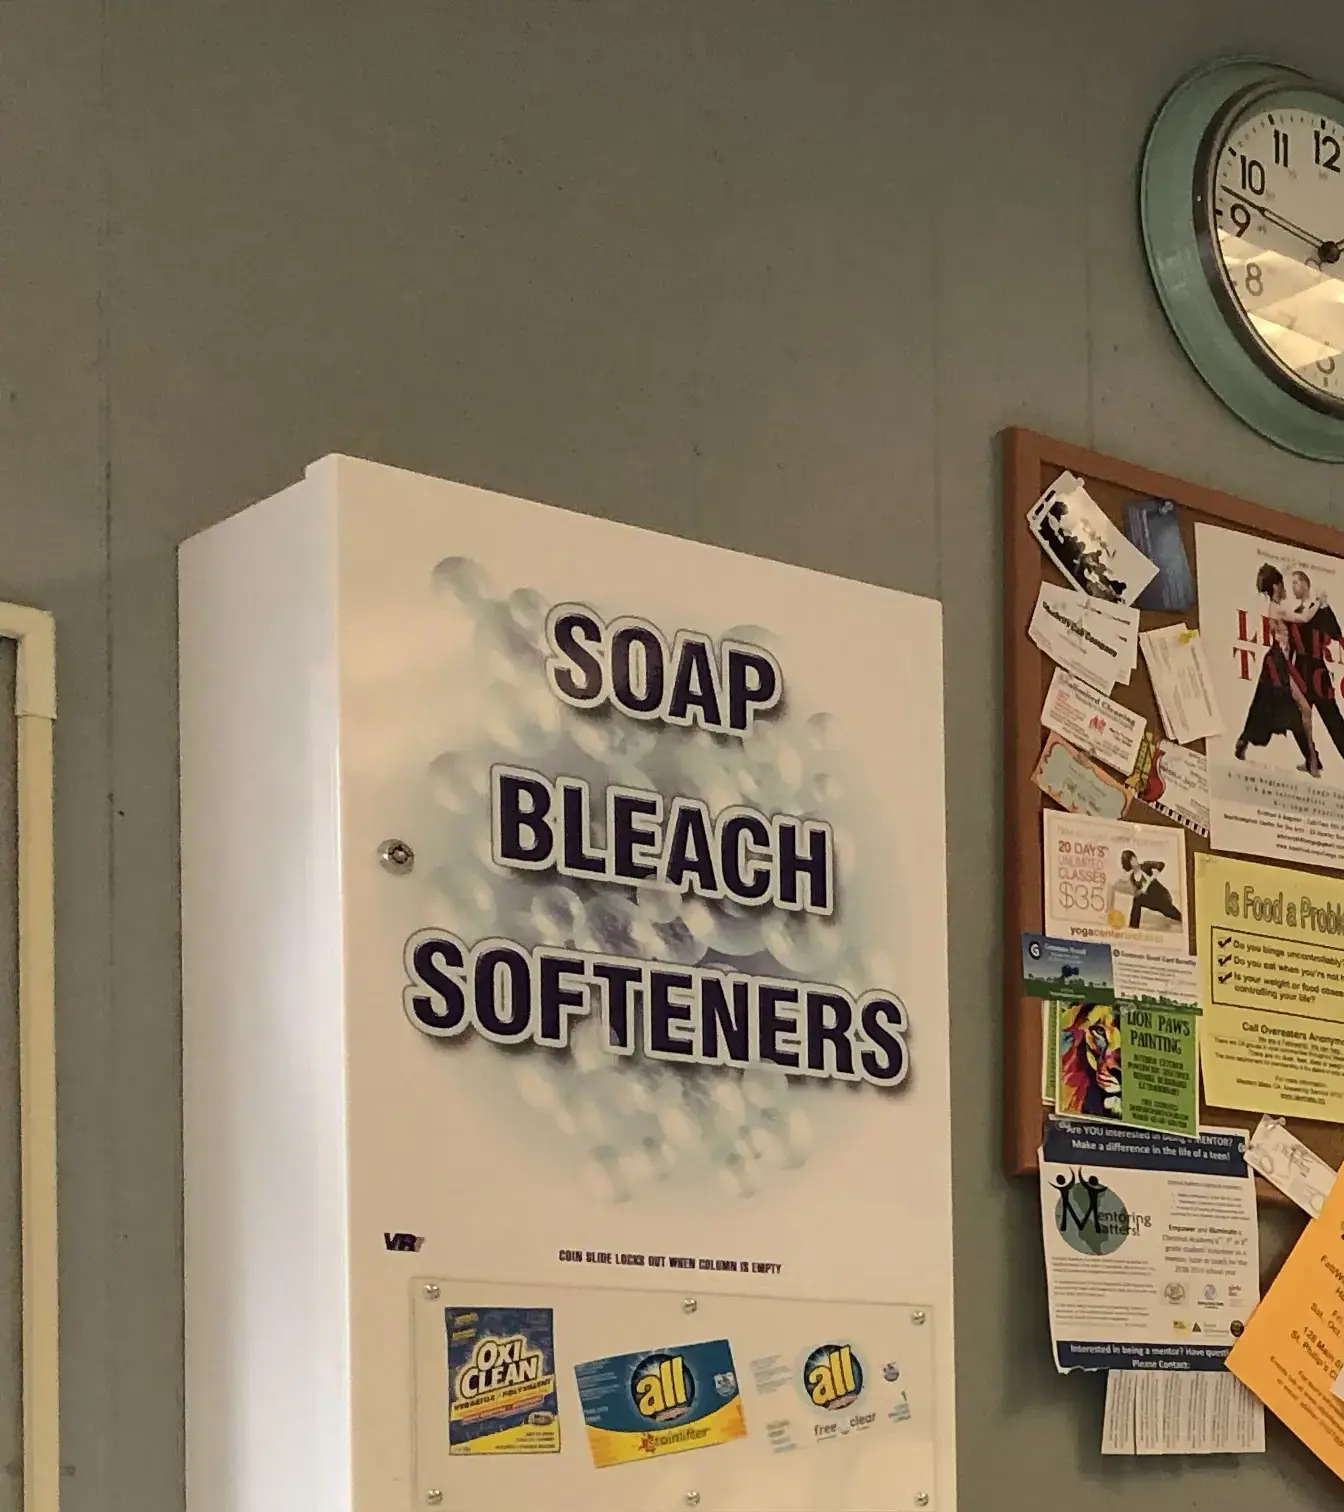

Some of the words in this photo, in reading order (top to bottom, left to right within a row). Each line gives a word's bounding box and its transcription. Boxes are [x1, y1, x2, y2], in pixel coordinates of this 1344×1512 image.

[1274, 129, 1288, 168] 11
[1315, 130, 1341, 173] 12
[1240, 155, 1265, 196] 10
[1230, 203, 1251, 237] 9
[1244, 262, 1263, 296] 8
[549, 608, 780, 734] SOAP
[1101, 699, 1136, 727] Cleaning
[496, 769, 830, 911] BLEACH
[1058, 840, 1071, 852] 20
[1074, 843, 1106, 857] DAYS
[1058, 867, 1106, 882] CLASSES
[1058, 880, 1105, 912] $35
[1225, 881, 1240, 917] Is
[1243, 885, 1284, 924] Food
[1286, 901, 1297, 927] a
[1233, 939, 1244, 949] Do
[1246, 942, 1261, 953] you
[1263, 945, 1285, 957] binge
[1233, 956, 1245, 965] Do
[1246, 958, 1262, 970] you
[1263, 962, 1276, 970] eat
[1278, 963, 1299, 974] when
[1301, 968, 1325, 981] you're
[1326, 972, 1339, 981] not
[1233, 972, 1242, 981] Is
[1243, 975, 1261, 986] your
[1263, 977, 1290, 989] weight
[1291, 982, 1300, 990] or
[1302, 983, 1320, 993] food
[409, 934, 906, 1082] SOFTENERS
[1234, 985, 1278, 1000] controlling
[1279, 992, 1297, 1002] your
[1299, 993, 1316, 1004] life?
[1127, 1010, 1152, 1029] LION
[1158, 1015, 1190, 1036] PAWS
[1242, 1021, 1259, 1033] Call
[1260, 1024, 1307, 1041] Overeaters
[1130, 1029, 1182, 1055] PAINTING
[1067, 1125, 1082, 1135] Are
[1084, 1126, 1104, 1136] YOU
[1106, 1128, 1150, 1140] interested
[1072, 1140, 1096, 1149] Make
[1106, 1142, 1150, 1154] difference
[1152, 1146, 1161, 1154] in
[1163, 1147, 1177, 1156] the
[1179, 1148, 1192, 1158] life
[1193, 1150, 1202, 1158] of
[1210, 1152, 1230, 1161] teen!
[1169, 1224, 1196, 1234] Empower
[559, 1250, 583, 1262] COIN
[586, 1252, 612, 1264] SLIDE
[615, 1254, 645, 1266] LOCKS
[648, 1256, 665, 1267] OUT
[669, 1256, 696, 1269] WHEN
[699, 1259, 737, 1272] COLUMN
[740, 1262, 749, 1272] IS
[752, 1263, 782, 1274] EMPTY
[476, 1338, 524, 1372] OXI
[1071, 1345, 1111, 1354] Interested
[1112, 1345, 1120, 1354] in
[1122, 1345, 1143, 1356] being
[1152, 1346, 1184, 1356] mentor?
[1185, 1348, 1203, 1357] Have
[1302, 1341, 1329, 1373] Philip's
[1303, 1326, 1318, 1343] 128
[1316, 1340, 1335, 1361] Main
[459, 1355, 540, 1400] CLEAN
[808, 1344, 856, 1406] all
[1132, 1360, 1157, 1369] Please
[1158, 1360, 1190, 1369] Contact:
[635, 1354, 687, 1416] all
[814, 1423, 837, 1437] free
[850, 1412, 876, 1427] clear
